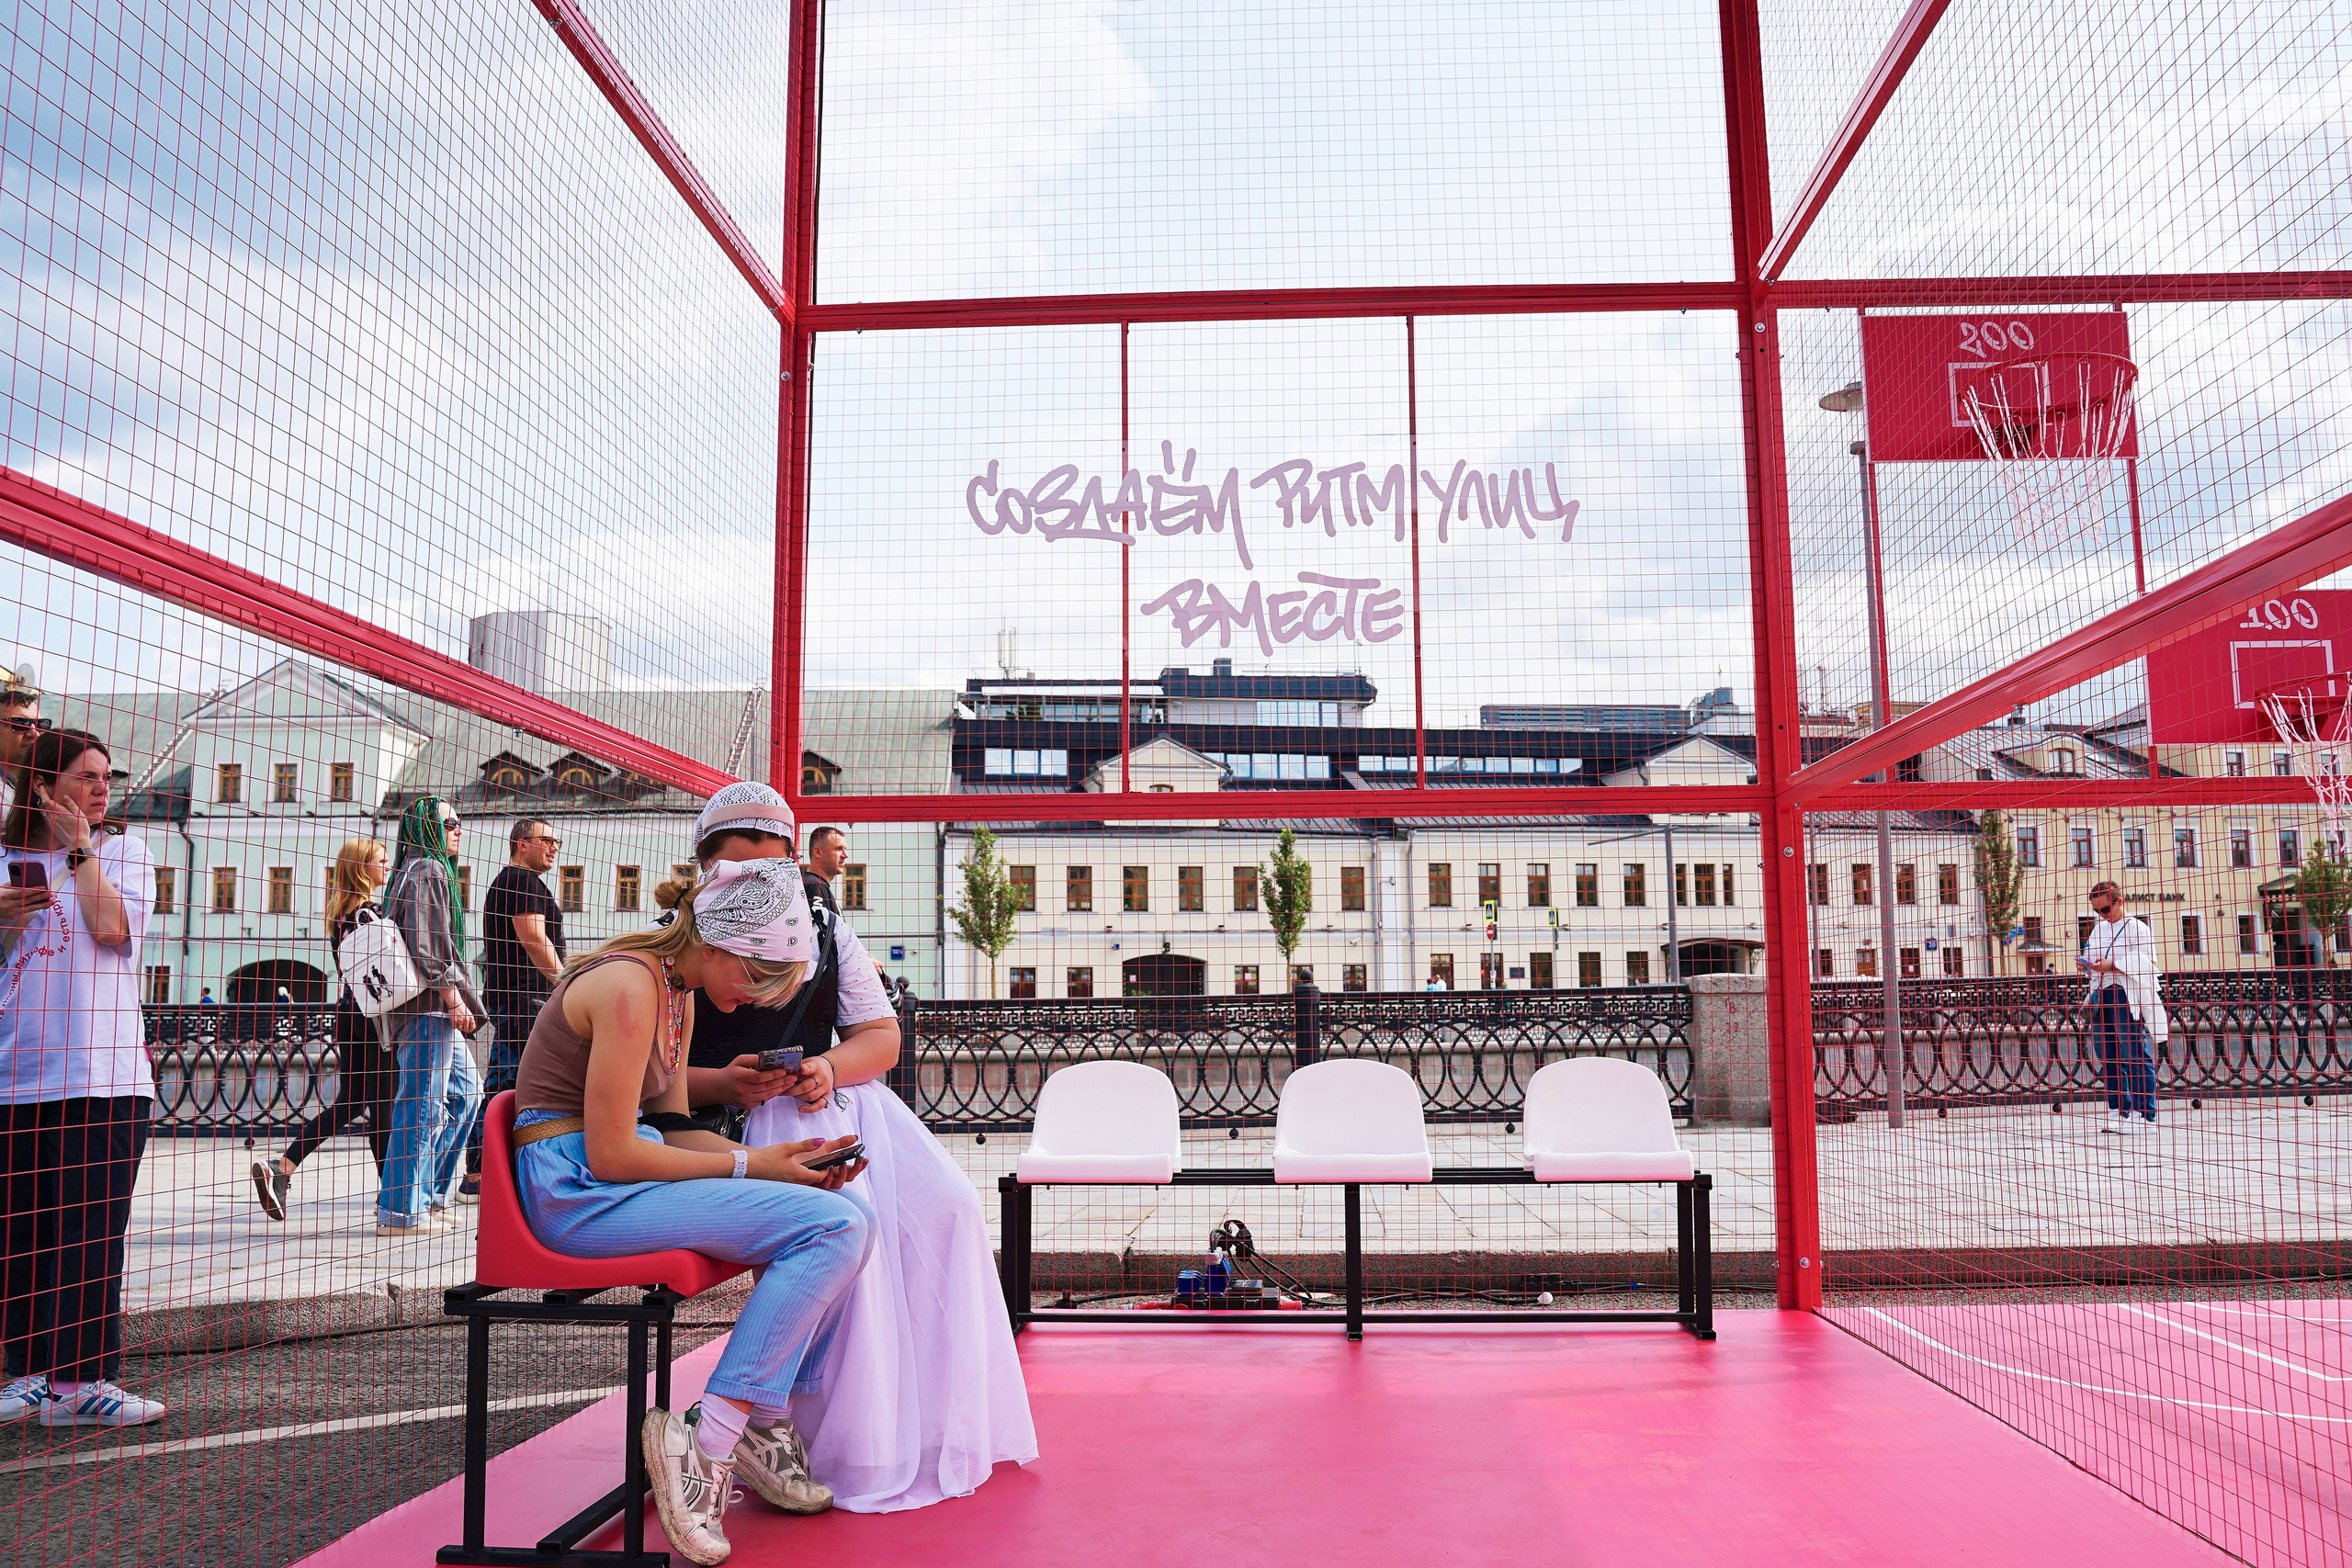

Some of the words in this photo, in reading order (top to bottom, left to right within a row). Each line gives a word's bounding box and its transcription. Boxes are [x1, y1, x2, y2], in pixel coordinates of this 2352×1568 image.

[1960, 321, 2035, 357] 200
[1250, 458, 1406, 541] РИТМ
[1420, 459, 1580, 542] УЛИЦ
[1141, 571, 1403, 656] ВМЕСТЕ
[2239, 598, 2319, 630] 100
[2124, 892, 2155, 902] АЛИСТ
[2158, 892, 2186, 902] БАНК
